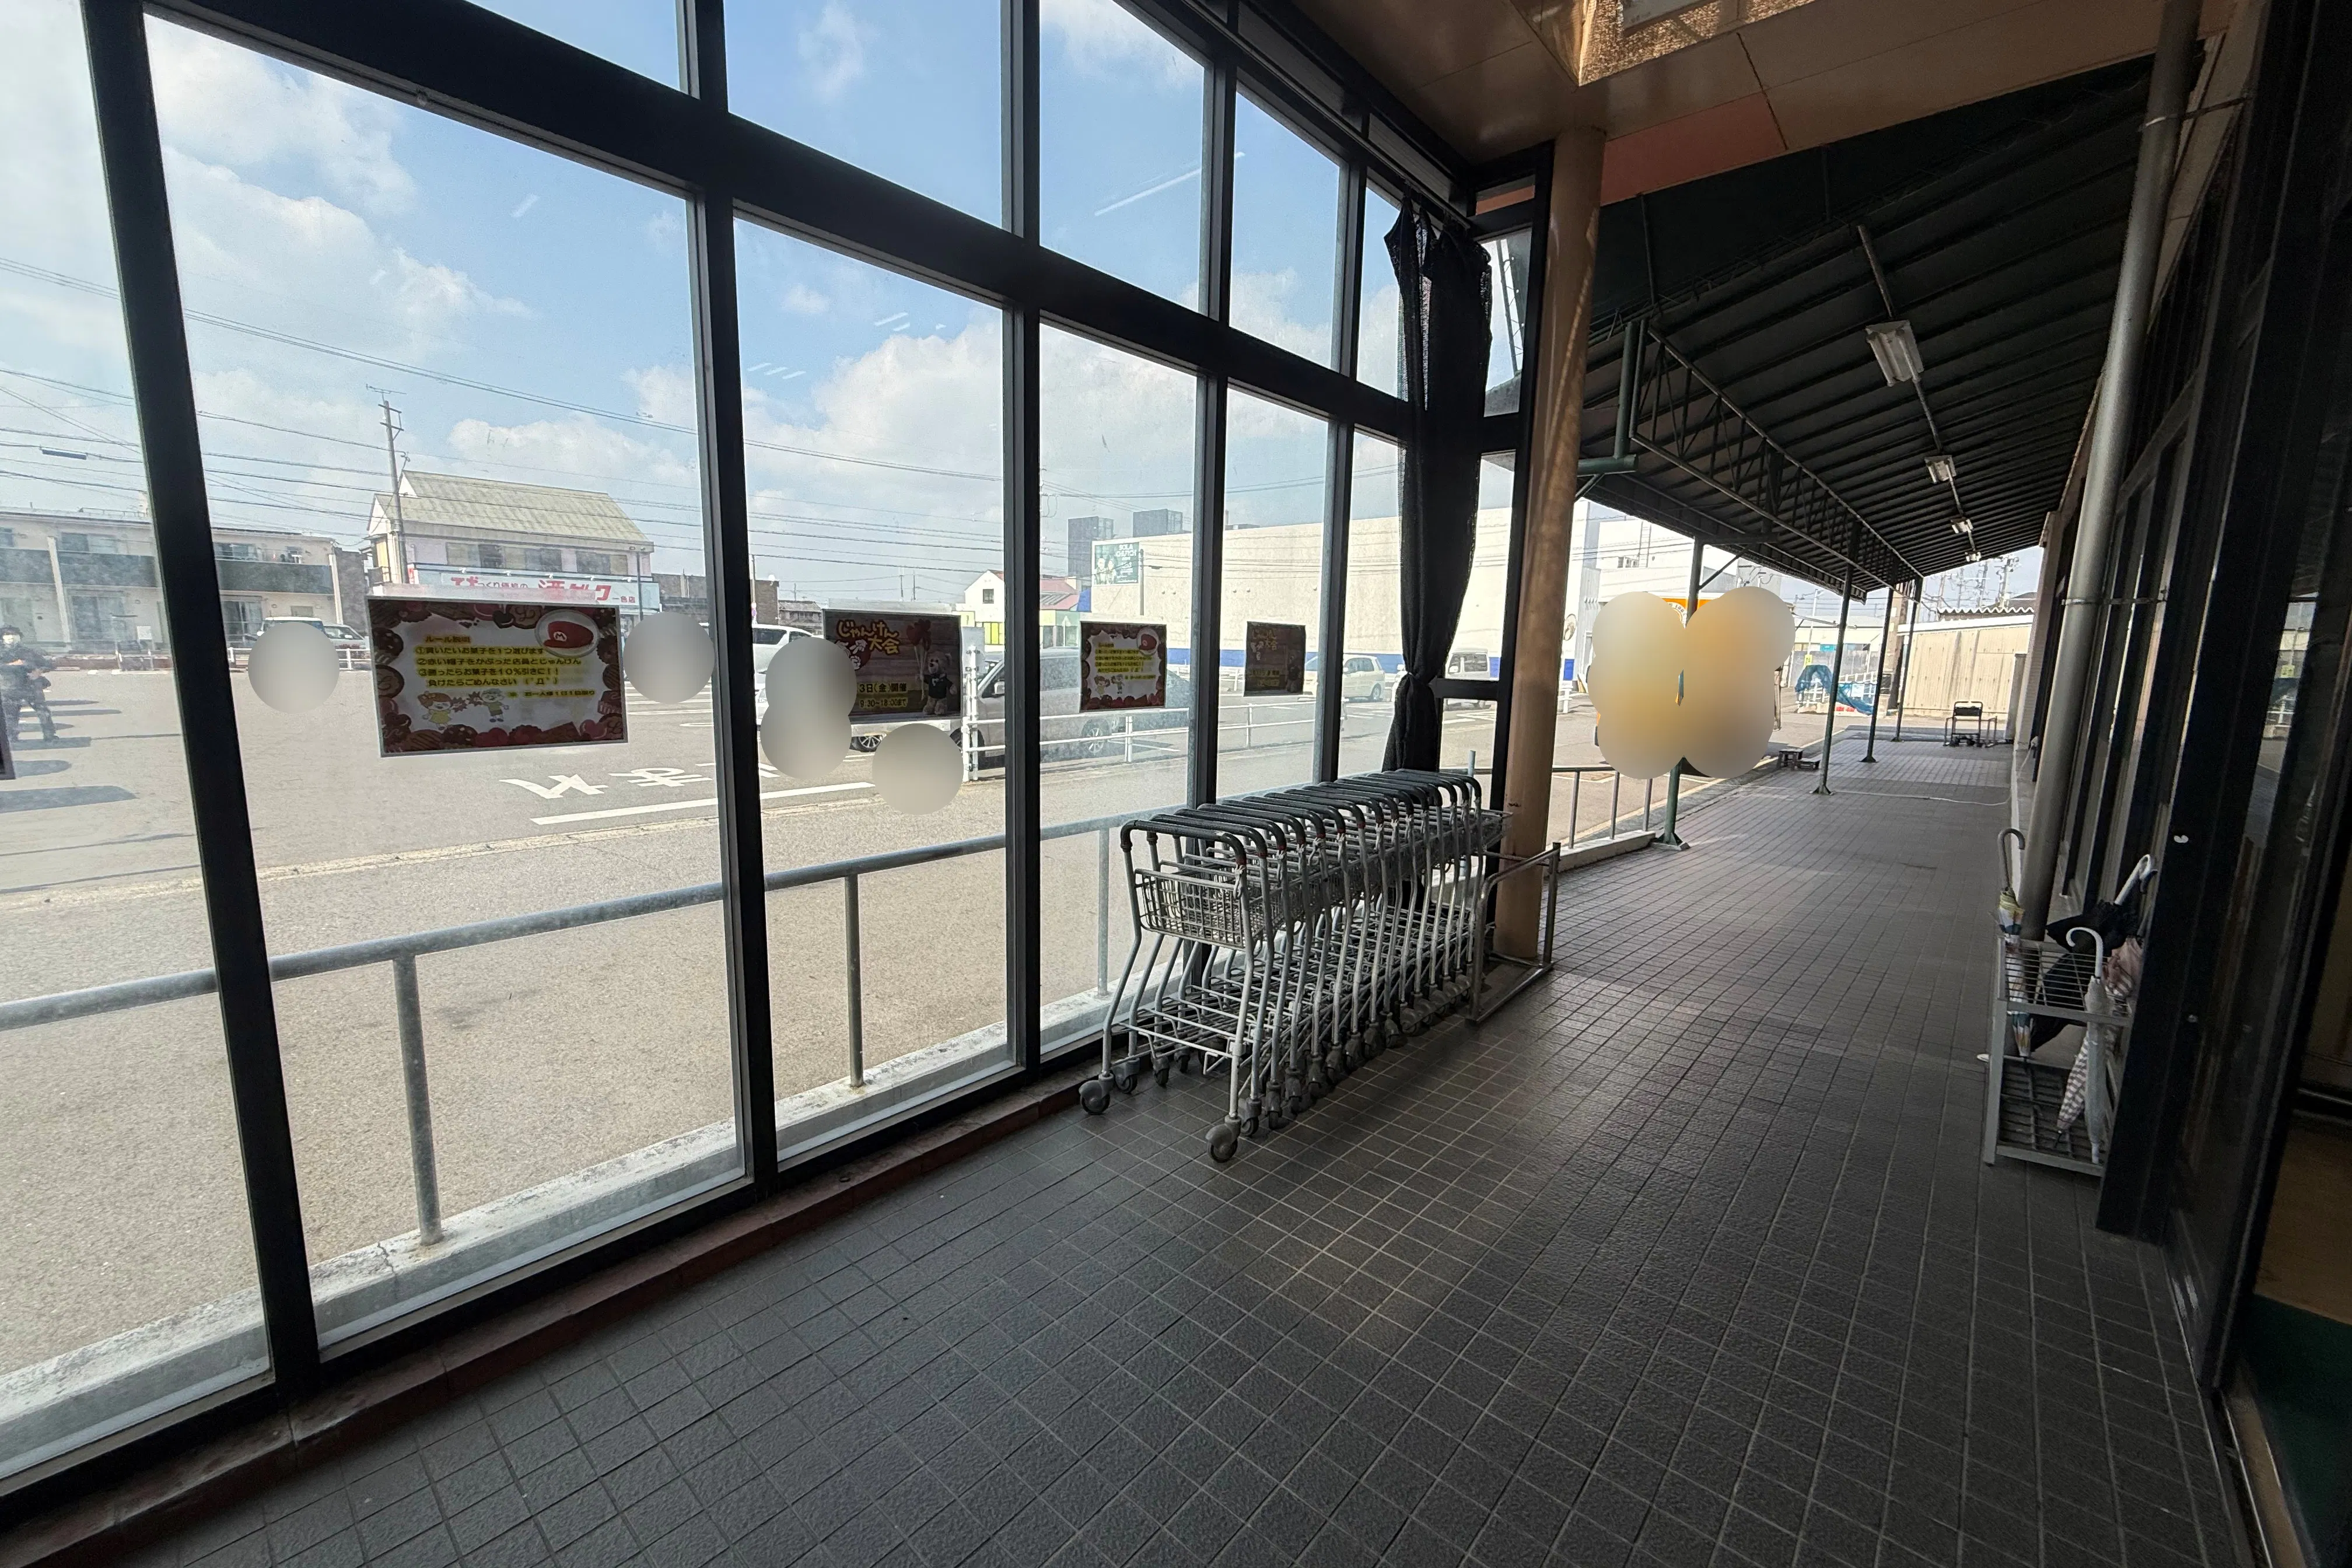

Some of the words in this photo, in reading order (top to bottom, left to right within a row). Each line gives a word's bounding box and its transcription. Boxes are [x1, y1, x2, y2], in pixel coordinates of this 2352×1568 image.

[838, 621, 898, 638] じゃんけん
[868, 635, 900, 654] 大会
[428, 678, 517, 687] 負けたらごめんなさい
